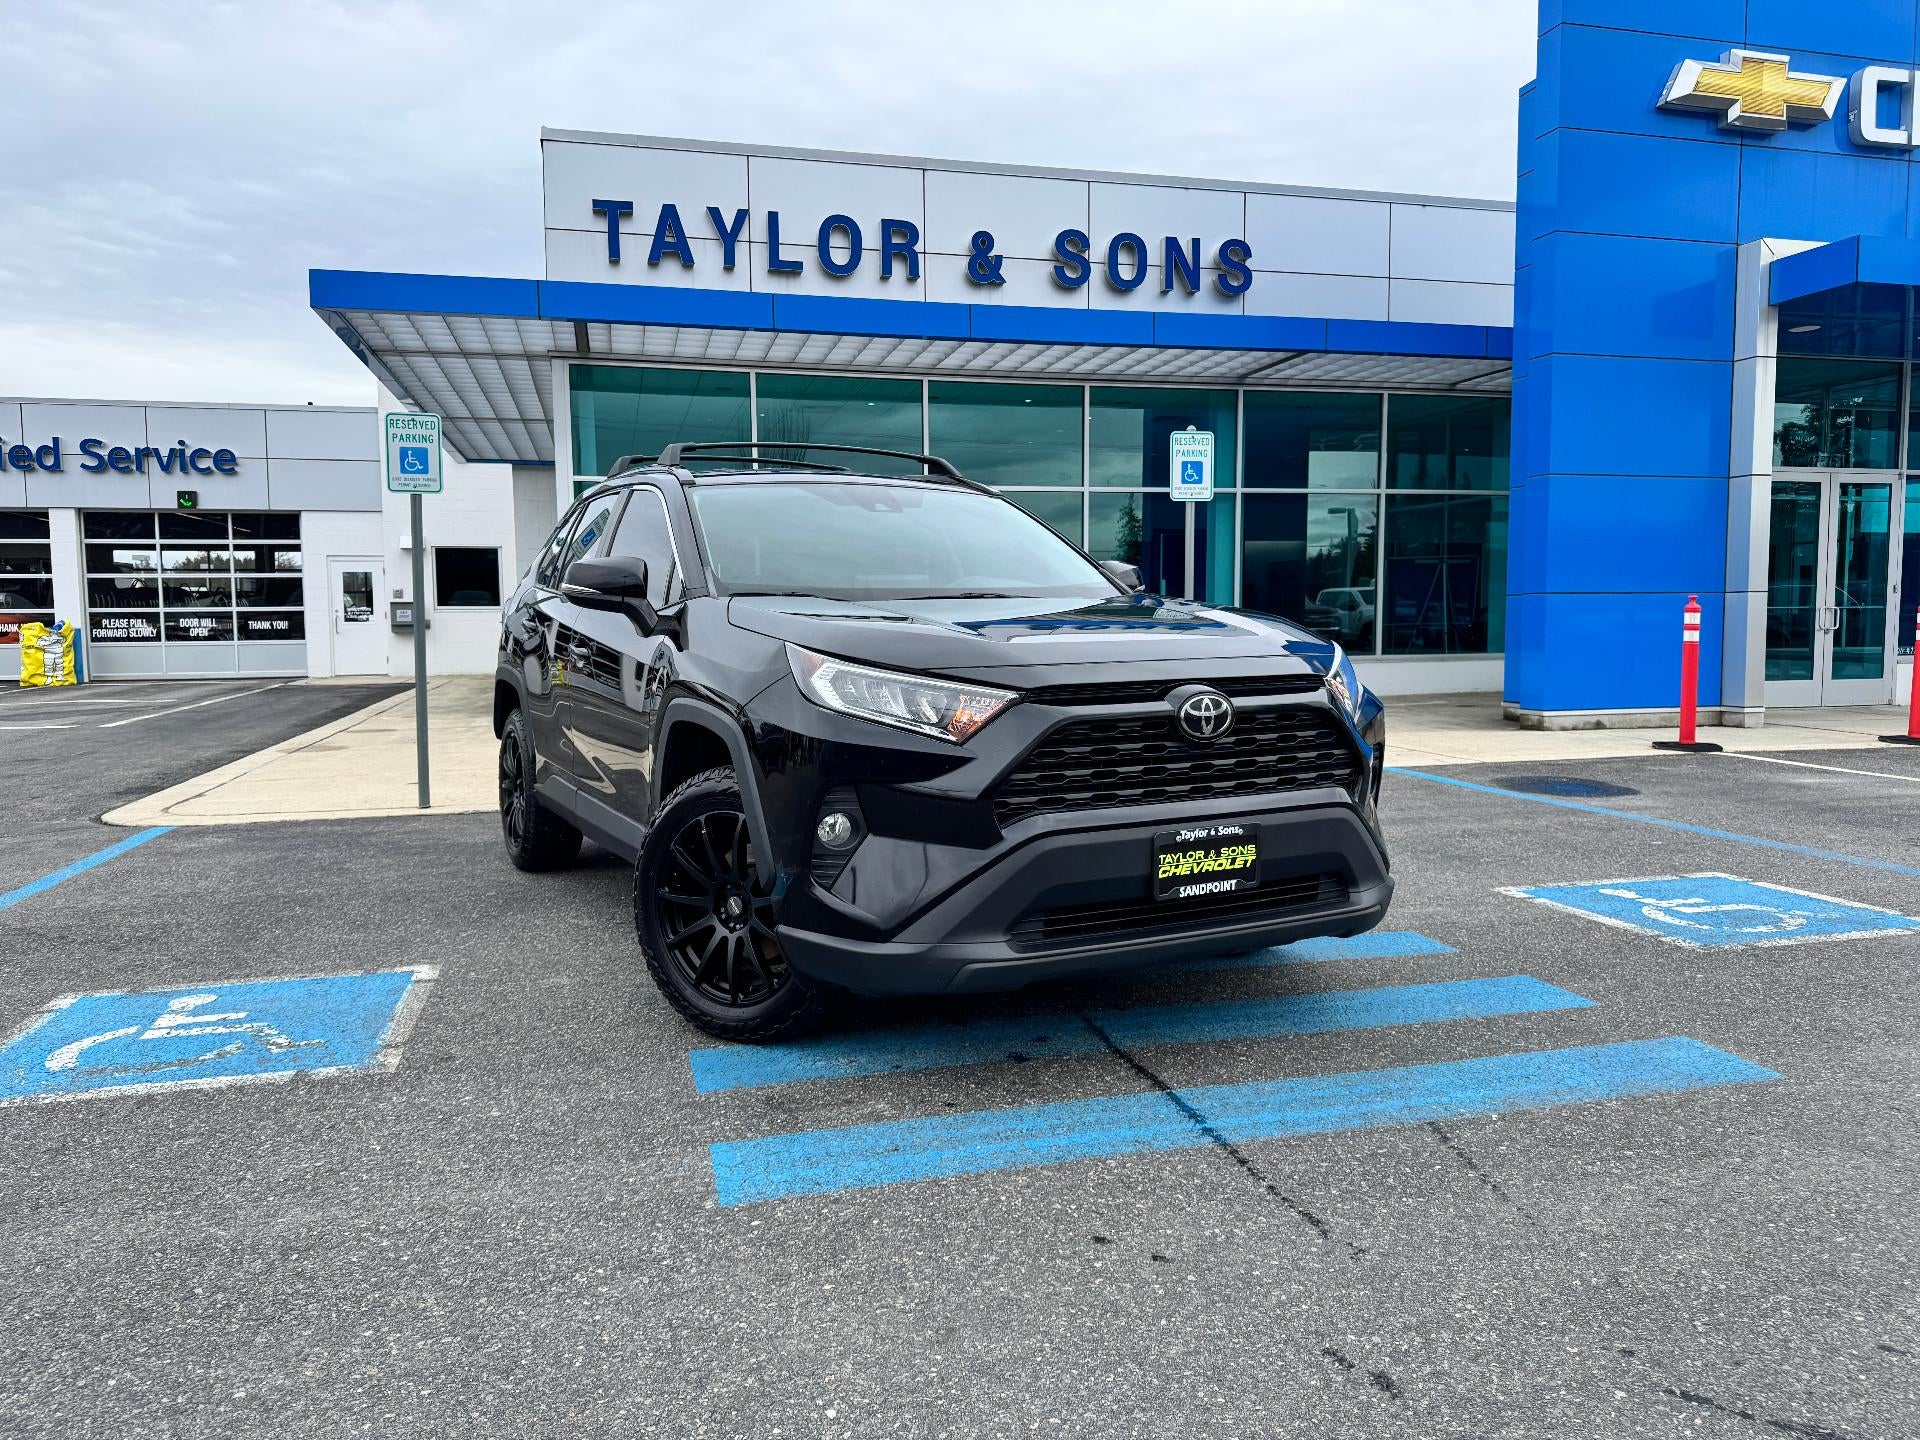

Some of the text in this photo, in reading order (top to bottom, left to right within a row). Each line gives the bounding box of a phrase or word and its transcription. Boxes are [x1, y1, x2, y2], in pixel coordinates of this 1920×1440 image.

[592, 198, 1254, 296] TAYLOR & SONS
[389, 418, 436, 430] RESERVED
[392, 432, 434, 444] PARKING
[1174, 437, 1210, 446] RESERVED
[79, 438, 239, 474] Service
[1175, 449, 1208, 458] PARKING
[102, 618, 149, 629] PLEASE PULL
[179, 618, 218, 628] DOOR WILL
[247, 620, 289, 630] THANK YOU!
[92, 628, 158, 638] FORWARD SLOWLY
[189, 627, 209, 637] OPEN
[1180, 828, 1208, 842] Taylor
[1217, 825, 1239, 836] Sons
[1159, 844, 1256, 865] TAYLOR & SONS
[1158, 855, 1257, 879] CHEVROLET
[1179, 880, 1238, 898] SANDPOINT
